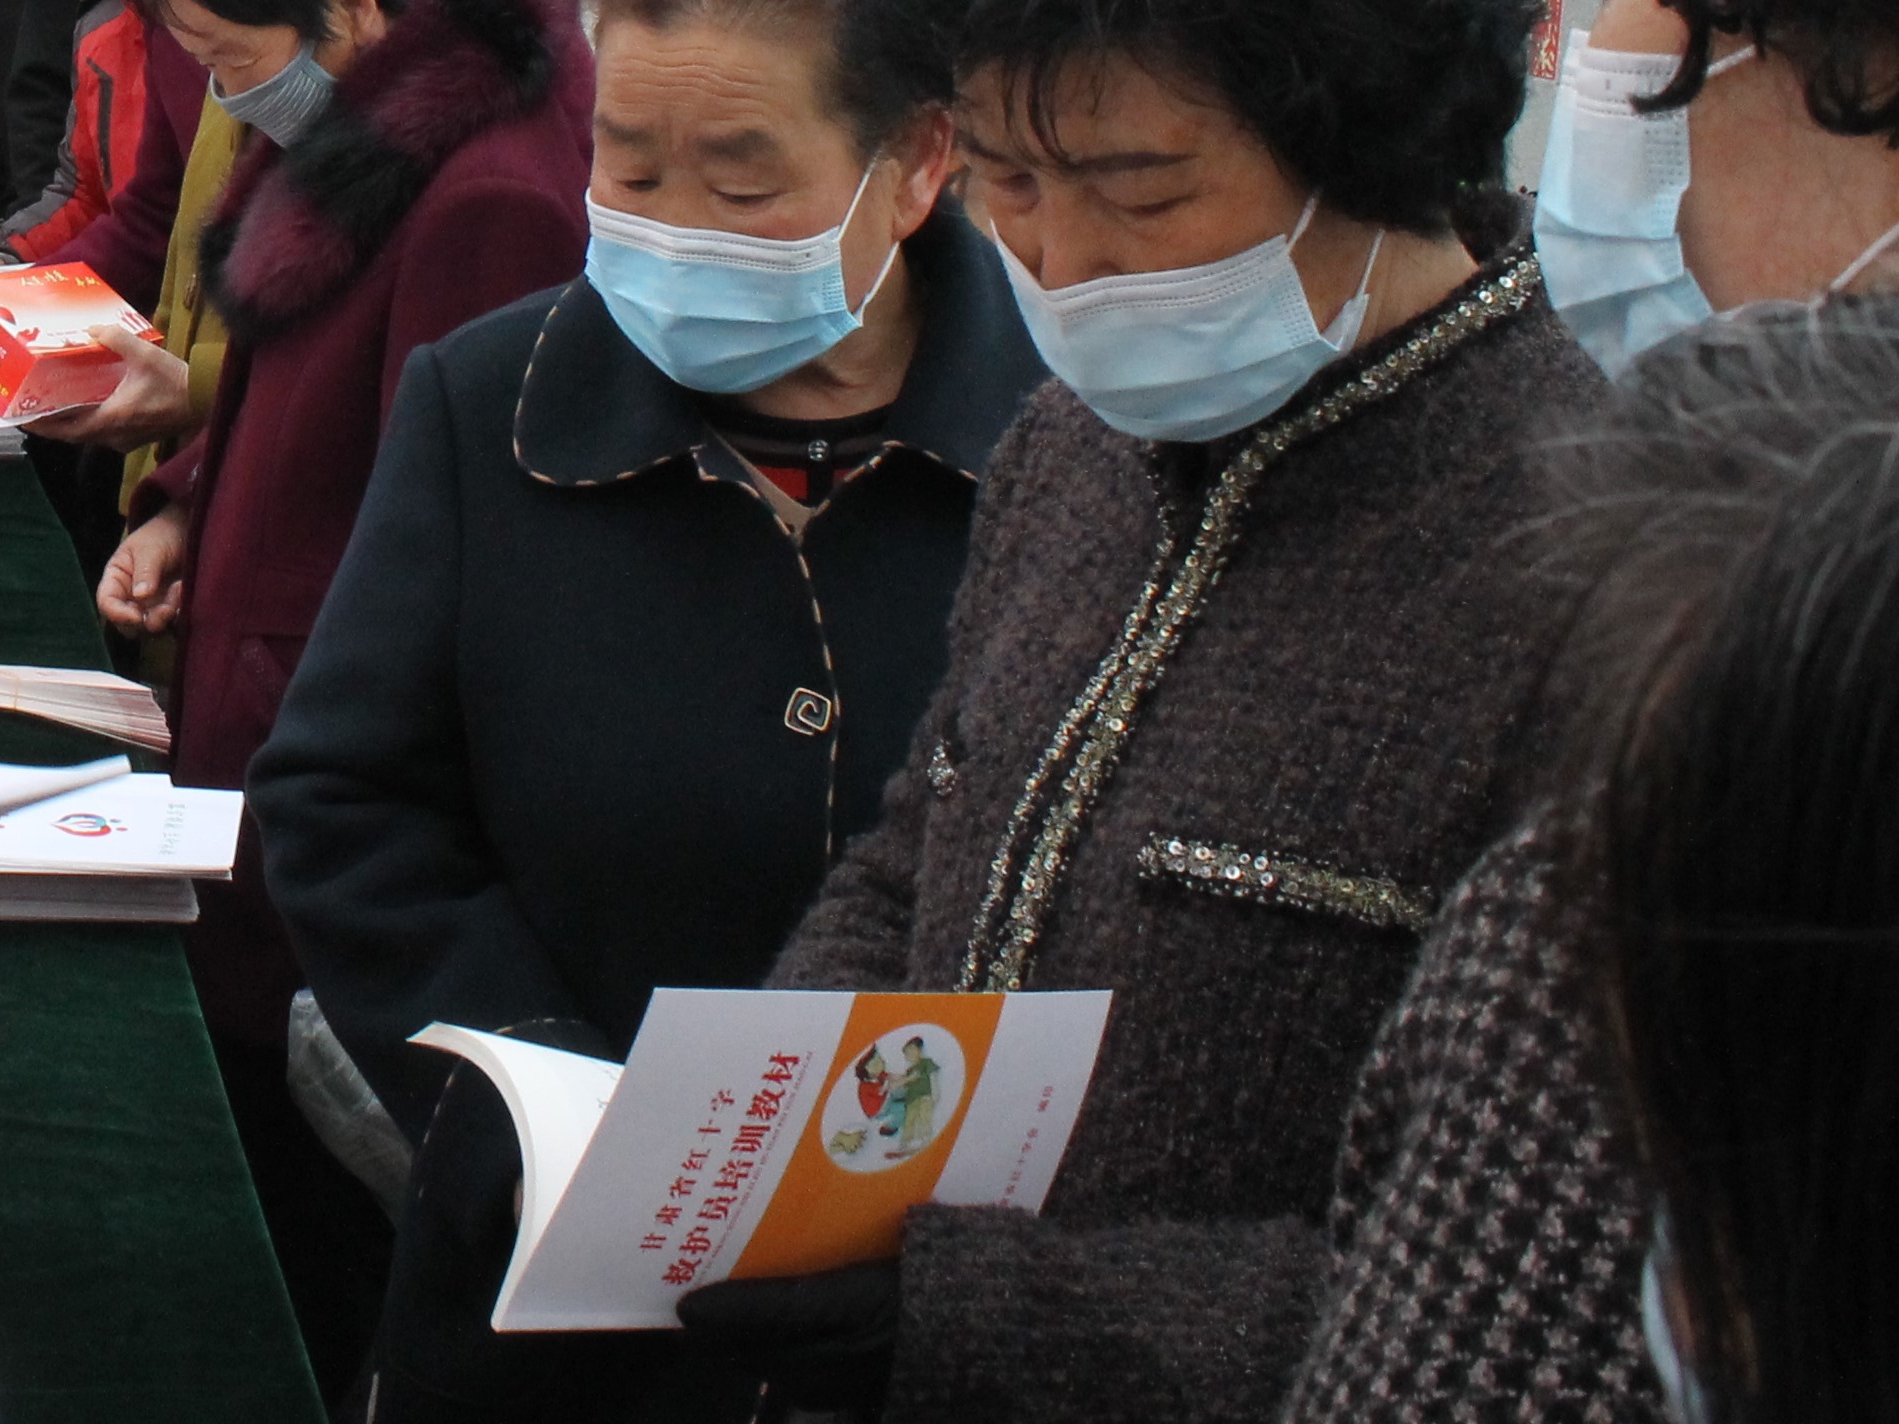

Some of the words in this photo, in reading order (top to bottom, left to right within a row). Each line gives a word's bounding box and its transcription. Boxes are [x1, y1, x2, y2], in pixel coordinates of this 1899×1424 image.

[638, 1088, 735, 1254] 甘肃省红十字
[661, 1050, 800, 1285] 救护员培训教材
